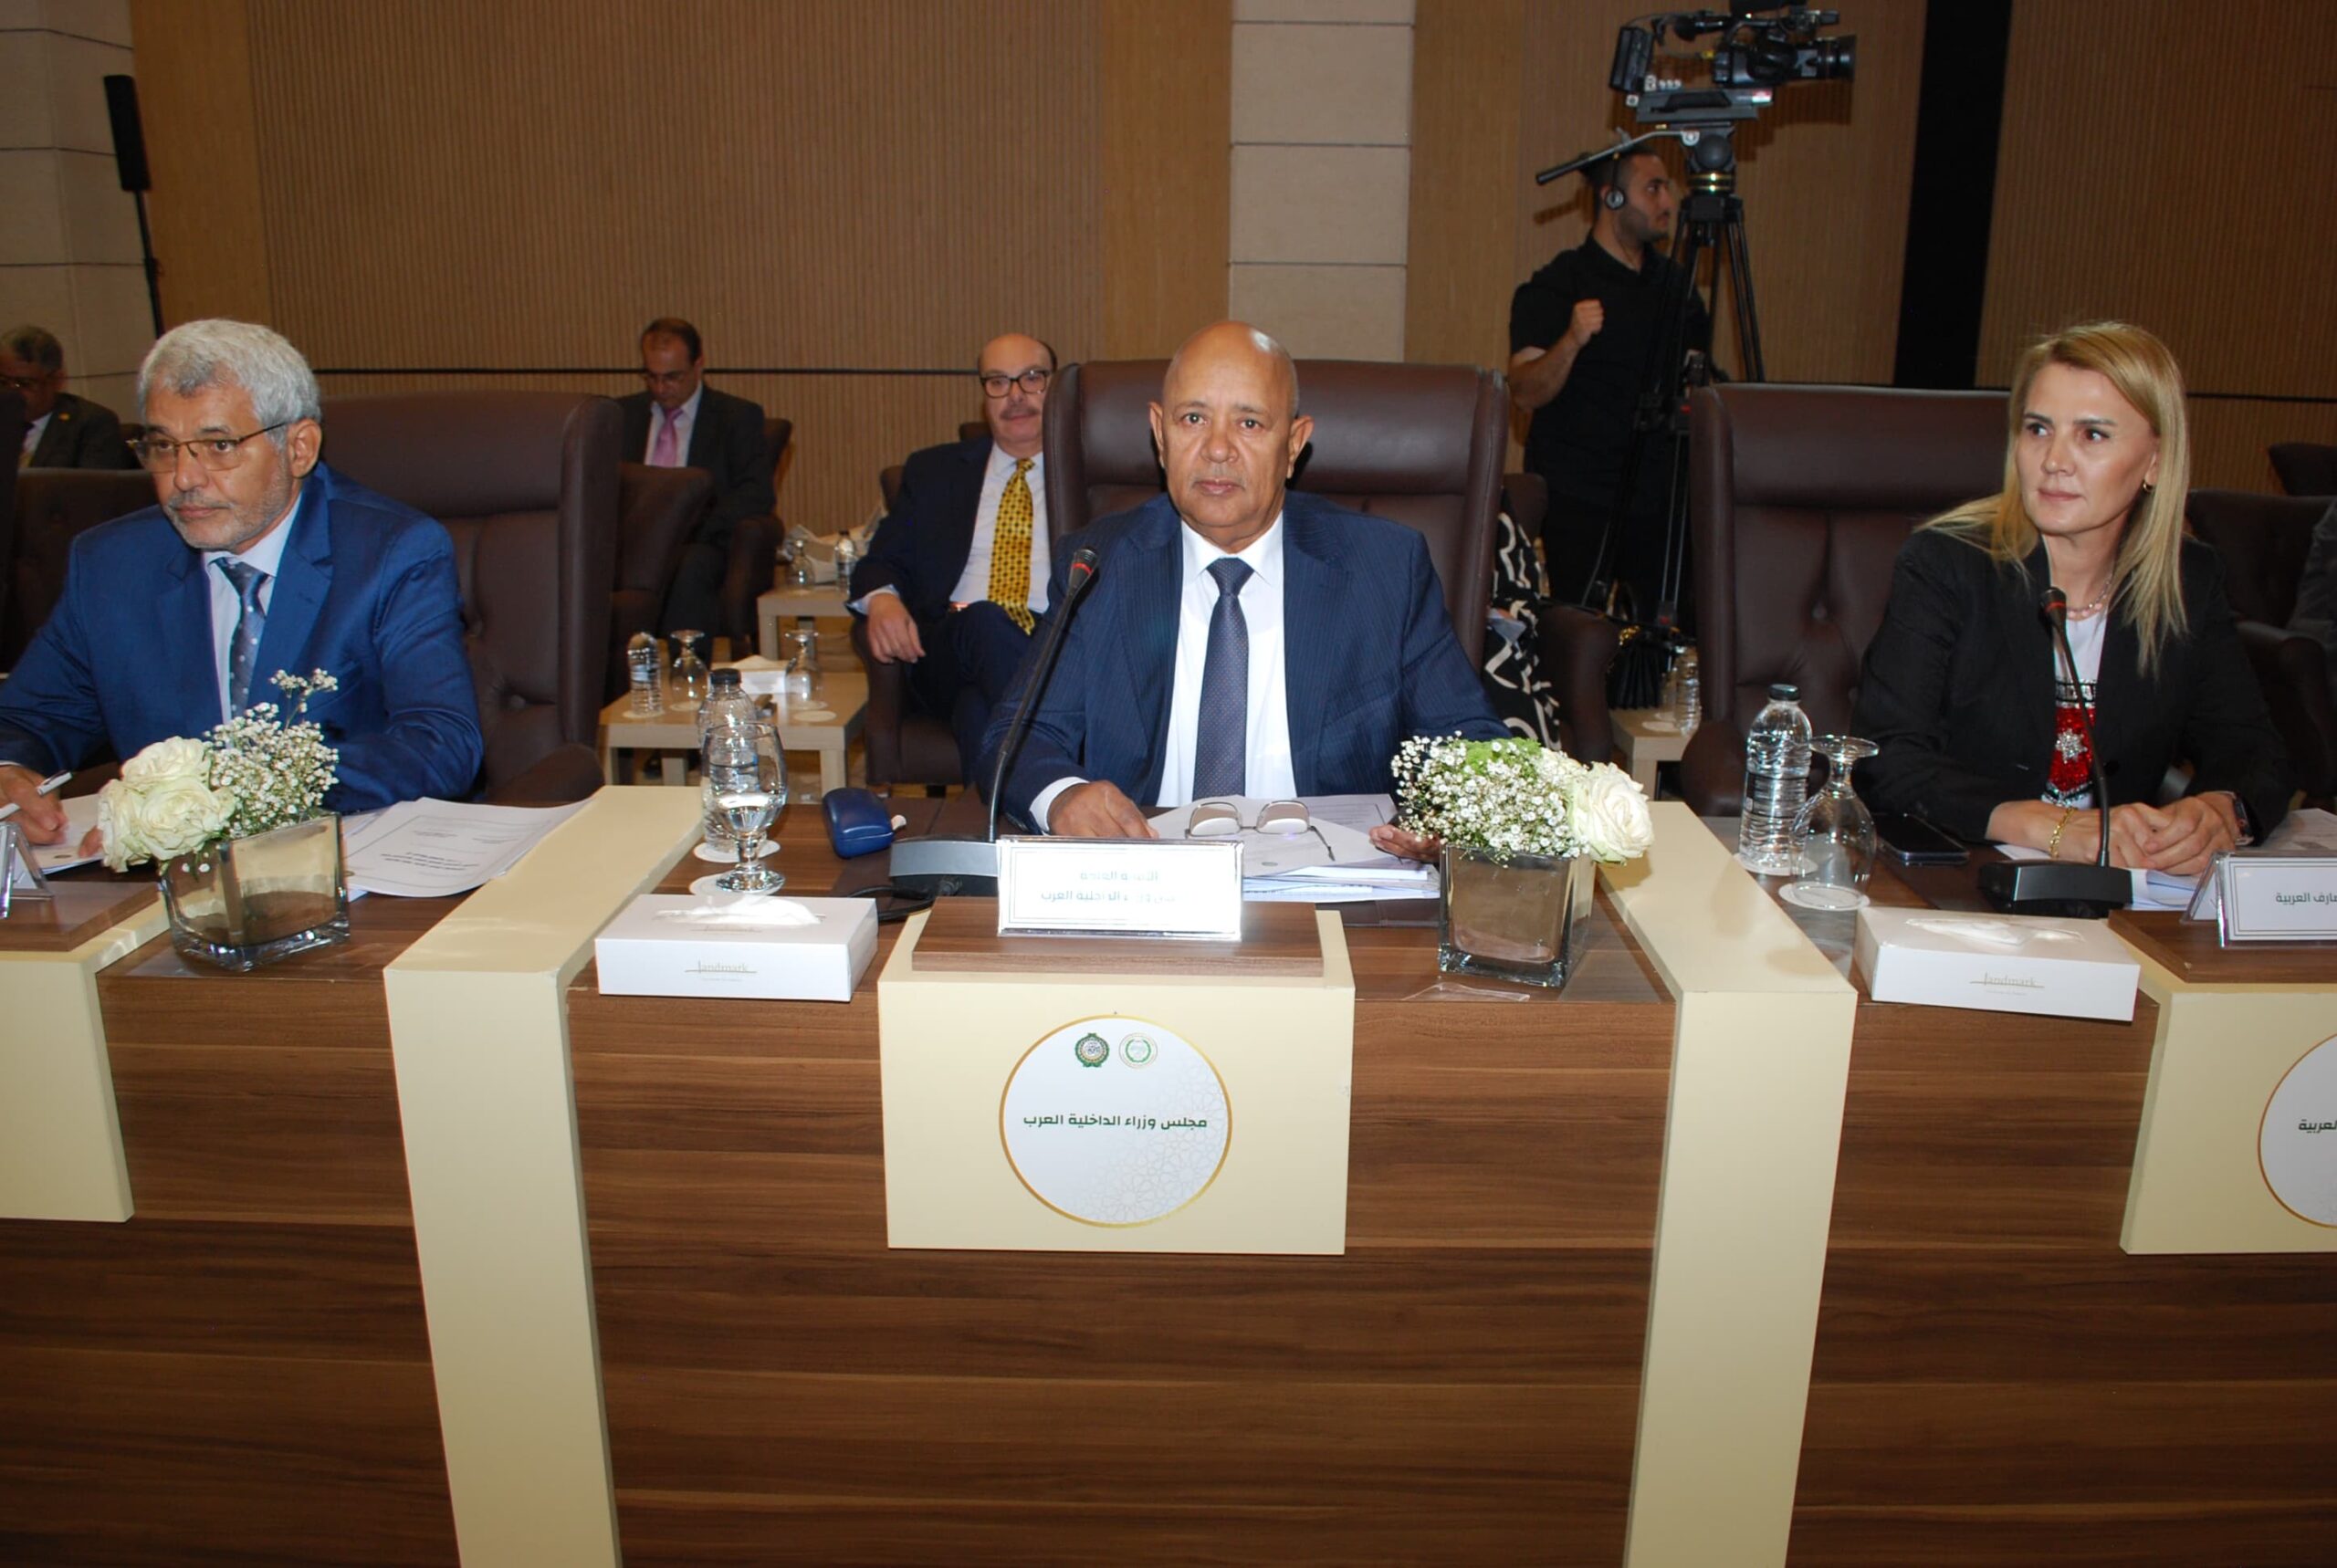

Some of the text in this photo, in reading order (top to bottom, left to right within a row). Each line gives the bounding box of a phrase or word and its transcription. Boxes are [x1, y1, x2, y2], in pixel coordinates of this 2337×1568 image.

[2275, 892, 2311, 905] العربية
[1023, 1113, 1208, 1131] مجلس وزراء الداخلية العرب
